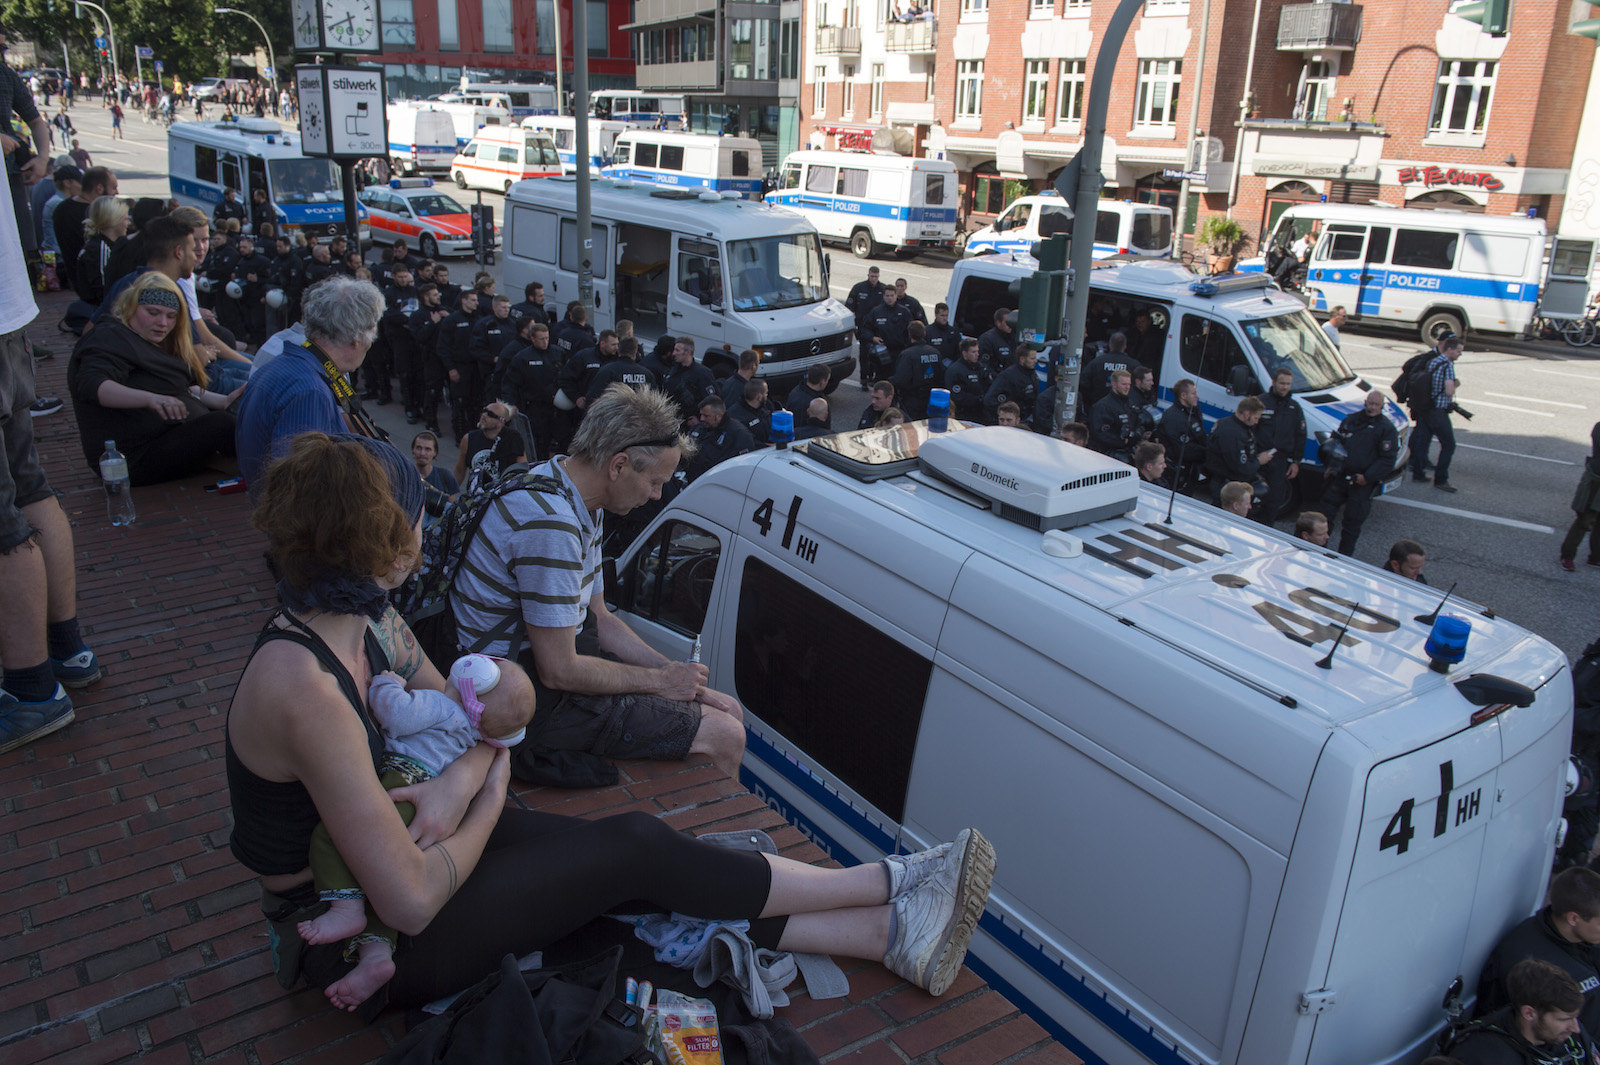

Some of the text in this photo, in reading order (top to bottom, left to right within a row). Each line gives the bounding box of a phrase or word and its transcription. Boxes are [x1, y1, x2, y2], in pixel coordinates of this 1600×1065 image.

[300, 77, 320, 89] stilwerk
[333, 78, 377, 91] stilwerk
[657, 174, 678, 184] POLIZEI
[1397, 166, 1420, 183] EL
[304, 207, 345, 215] POLIZE
[834, 201, 860, 213] POLIZEI
[1388, 274, 1441, 289] POLIZEI
[920, 354, 938, 364] POLIZEI
[1104, 362, 1127, 371] POLIZEI
[623, 374, 646, 383] POLIZEI
[979, 466, 1020, 491] Dometic
[752, 497, 774, 537] 4
[796, 534, 819, 565] HH
[1379, 797, 1415, 856] 4
[1455, 787, 1482, 828] HH
[687, 1042, 710, 1051] FILTER
